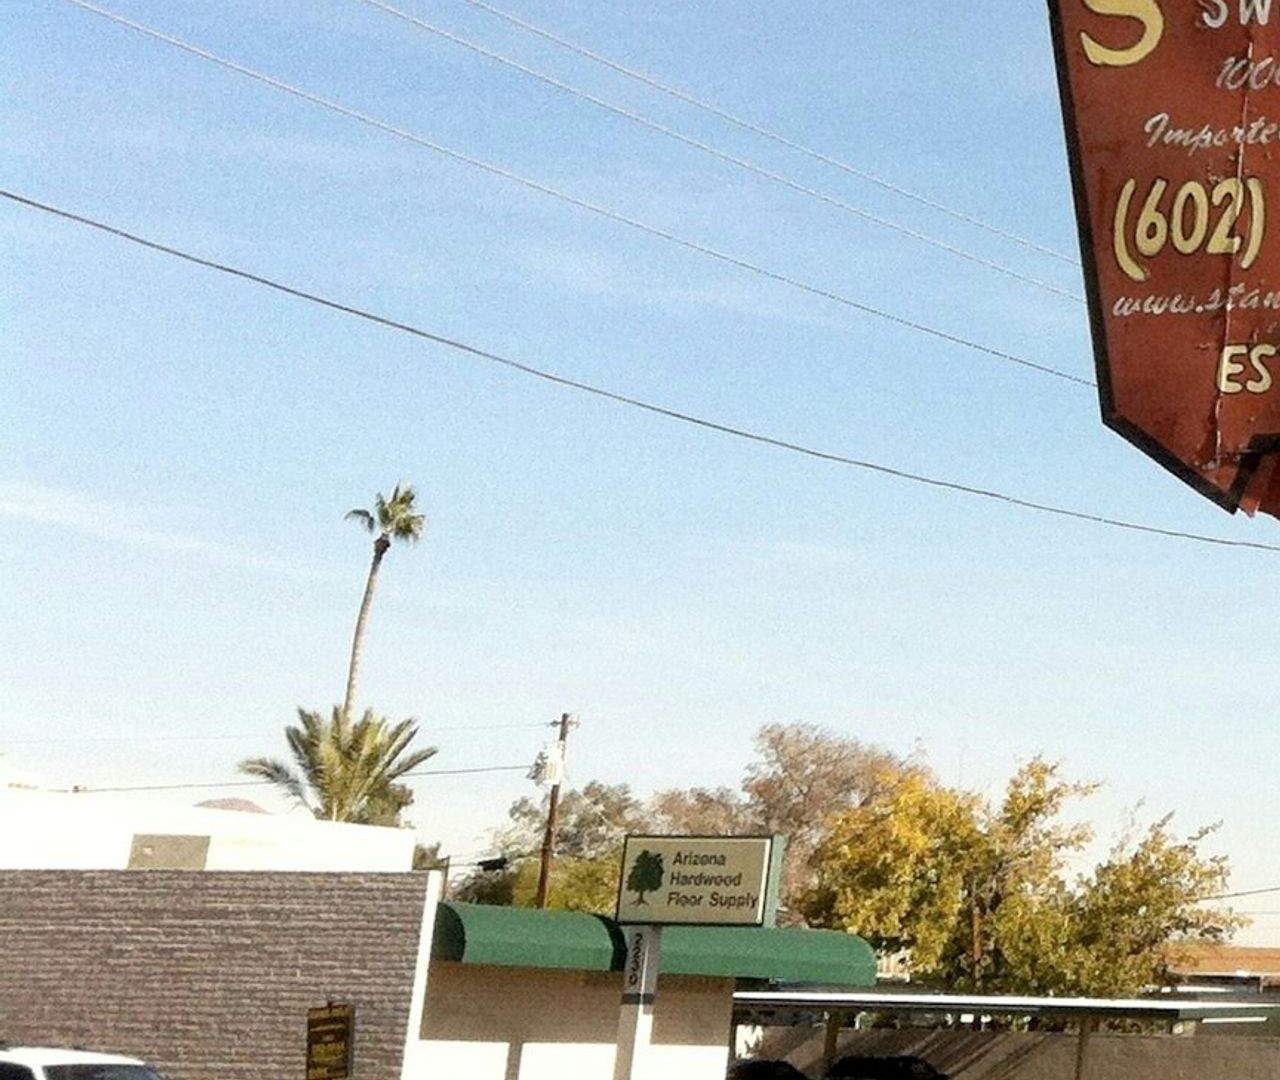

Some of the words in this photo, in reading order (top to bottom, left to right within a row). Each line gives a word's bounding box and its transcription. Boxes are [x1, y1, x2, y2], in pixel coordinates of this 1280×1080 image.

[1112, 176, 1267, 284] (602)
[672, 851, 727, 867] Arizona
[669, 872, 743, 887] Hardwood
[666, 891, 704, 908] Floor
[708, 892, 760, 911] Supply
